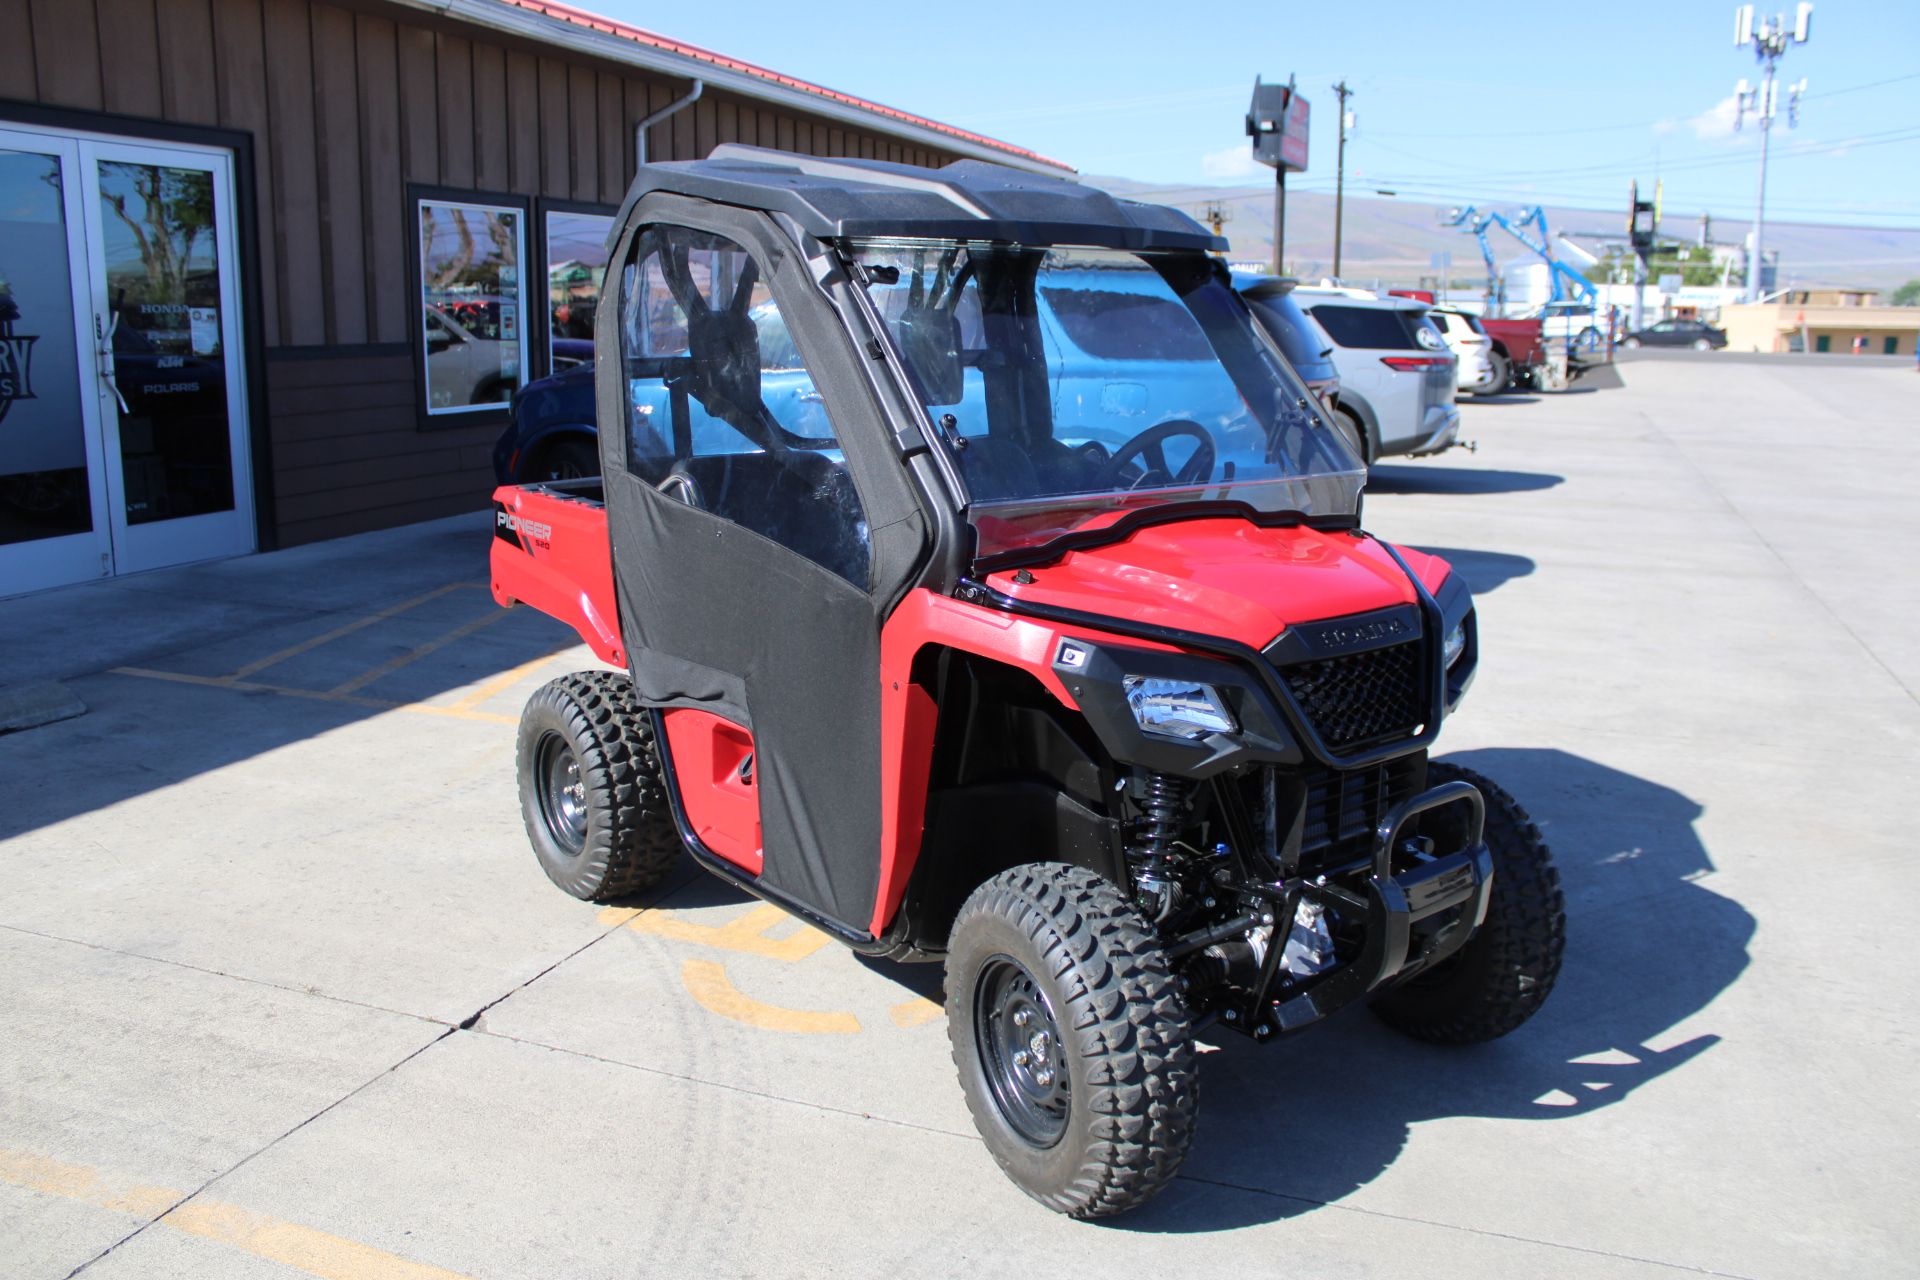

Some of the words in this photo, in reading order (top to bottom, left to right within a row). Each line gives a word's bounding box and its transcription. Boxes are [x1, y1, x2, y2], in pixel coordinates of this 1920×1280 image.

[141, 304, 190, 314] HONDA
[157, 355, 184, 368] KTM
[143, 382, 200, 395] POLARIS
[497, 511, 552, 541] PIONEER
[1320, 617, 1413, 648] HONDA
